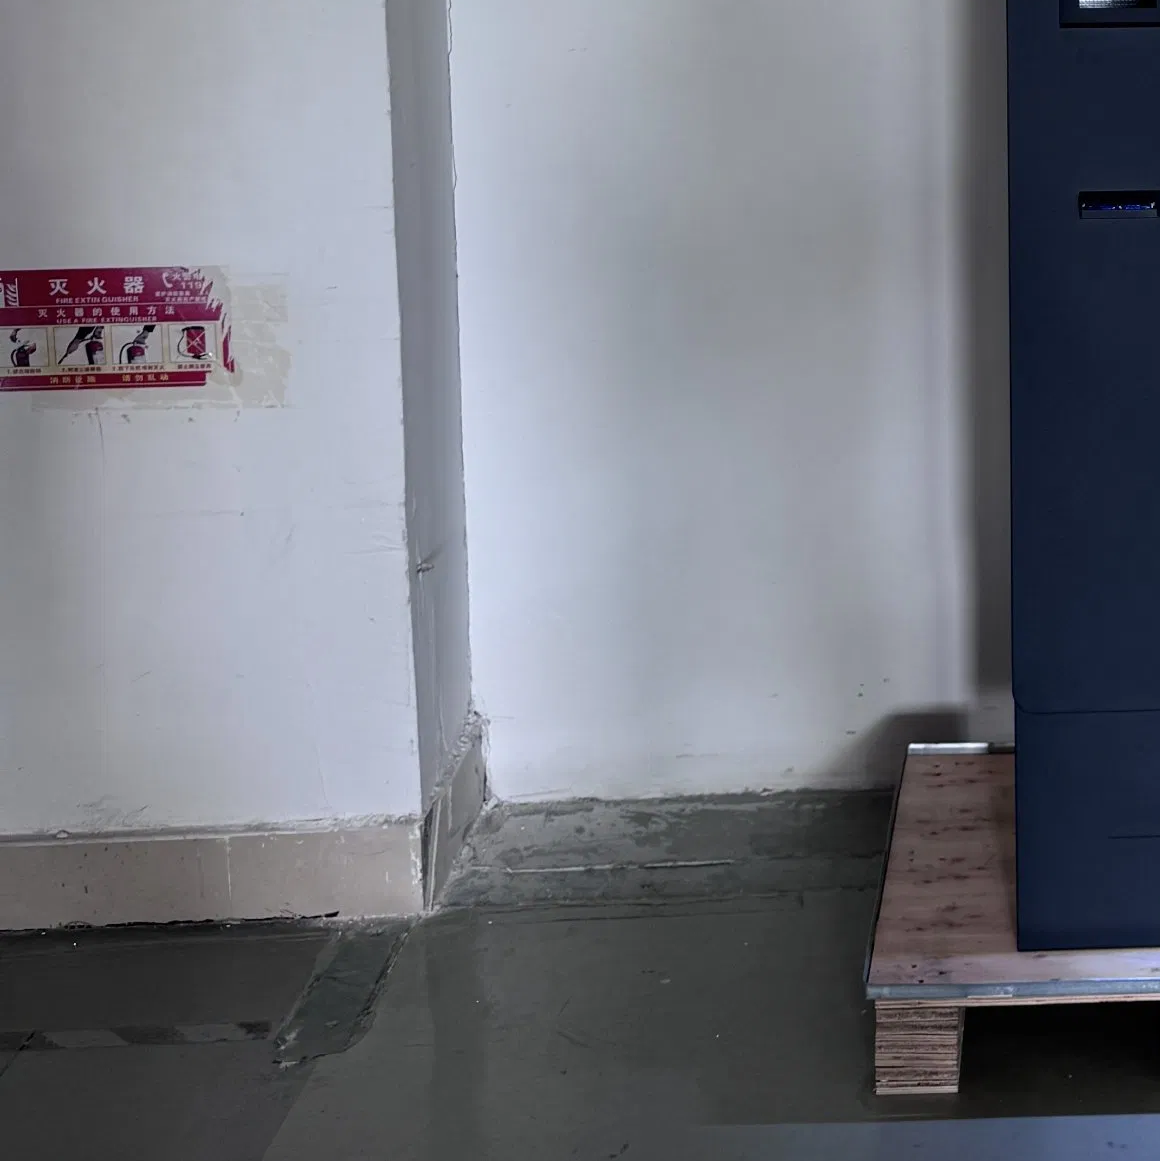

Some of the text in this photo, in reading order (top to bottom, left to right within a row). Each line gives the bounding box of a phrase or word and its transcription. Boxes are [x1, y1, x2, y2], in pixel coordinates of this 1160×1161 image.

[48, 276, 145, 297] 灭火器
[55, 297, 73, 305] FIRE
[37, 305, 175, 318] 灭火器的使用方法
[56, 317, 72, 325] USE
